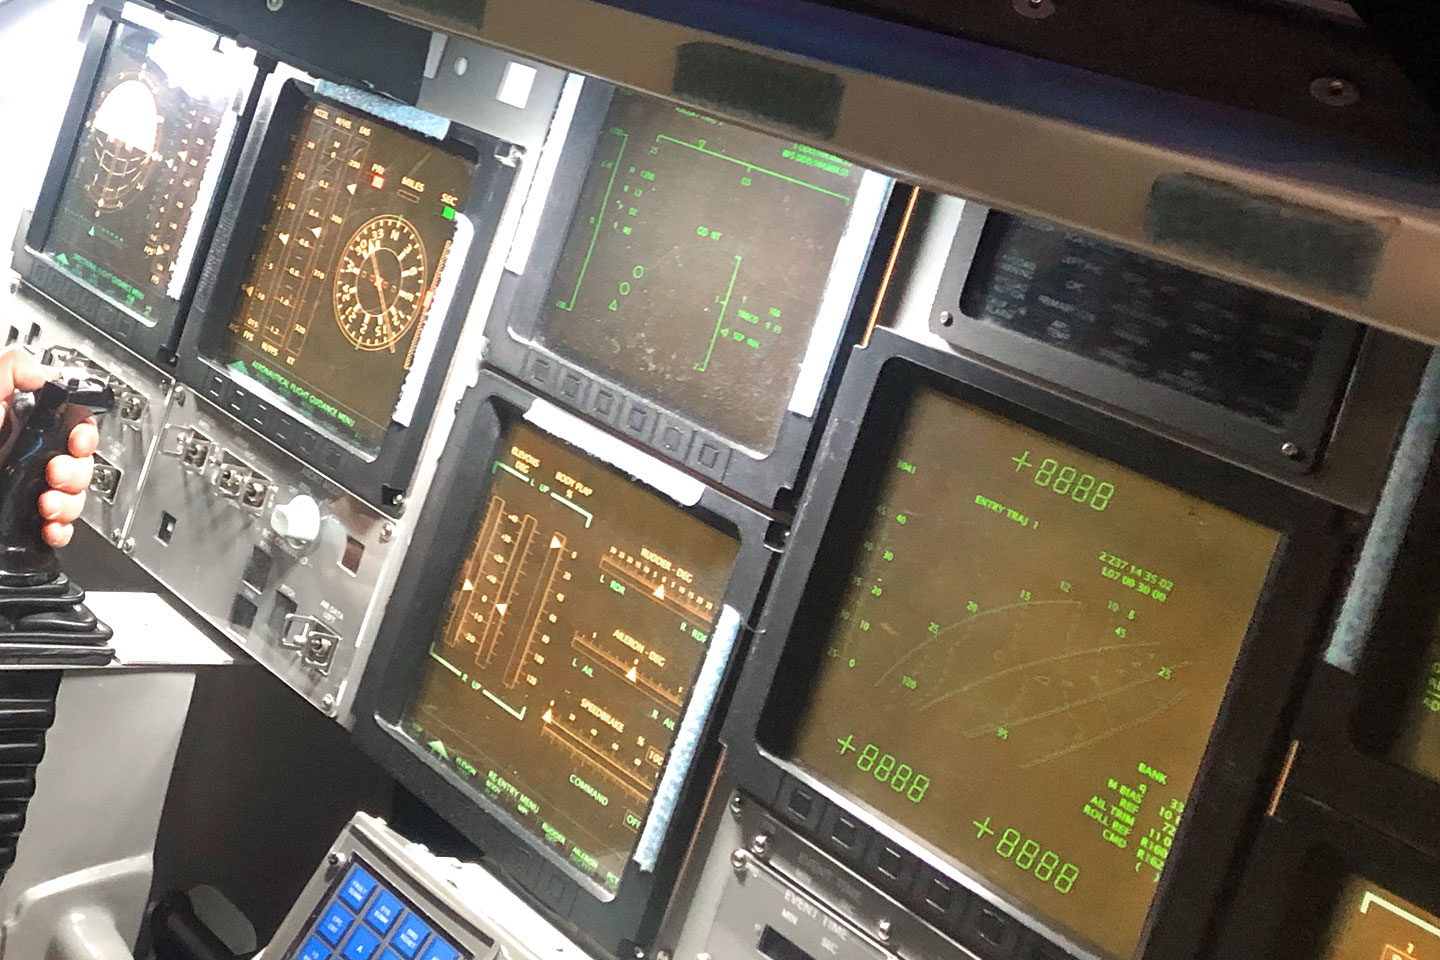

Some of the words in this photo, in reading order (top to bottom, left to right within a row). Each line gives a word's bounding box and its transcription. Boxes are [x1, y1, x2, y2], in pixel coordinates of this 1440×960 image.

[400, 175, 425, 193] MILES
[440, 193, 458, 207] SEC
[371, 228, 384, 240] 33
[389, 229, 400, 241] N
[252, 360, 289, 388] AERONAUTICAL
[290, 383, 310, 399] FLIGHT
[309, 395, 338, 418] GUIDANCE
[338, 411, 356, 427] MENU
[511, 446, 540, 467] ELEVONS
[555, 471, 576, 487] BODY
[575, 482, 593, 496] FLAP
[975, 495, 1005, 514] ENTRY
[1007, 508, 1029, 526] TRAJ
[641, 548, 672, 571] RUDDER
[676, 567, 693, 583] DEG
[613, 629, 645, 654] AILERON
[648, 650, 666, 667] DEG
[580, 698, 624, 733] SPEEDBRAKE
[1138, 762, 1167, 785] BANK
[569, 774, 609, 806] COMMAND
[1120, 785, 1143, 803] BIAS
[520, 794, 540, 814] MENU
[1083, 804, 1108, 826] ROLL
[1111, 805, 1135, 826] TRIM
[1103, 829, 1127, 848] CMD
[781, 908, 798, 926] MIN
[784, 889, 818, 918] EVENT
[822, 916, 848, 941] TIME
